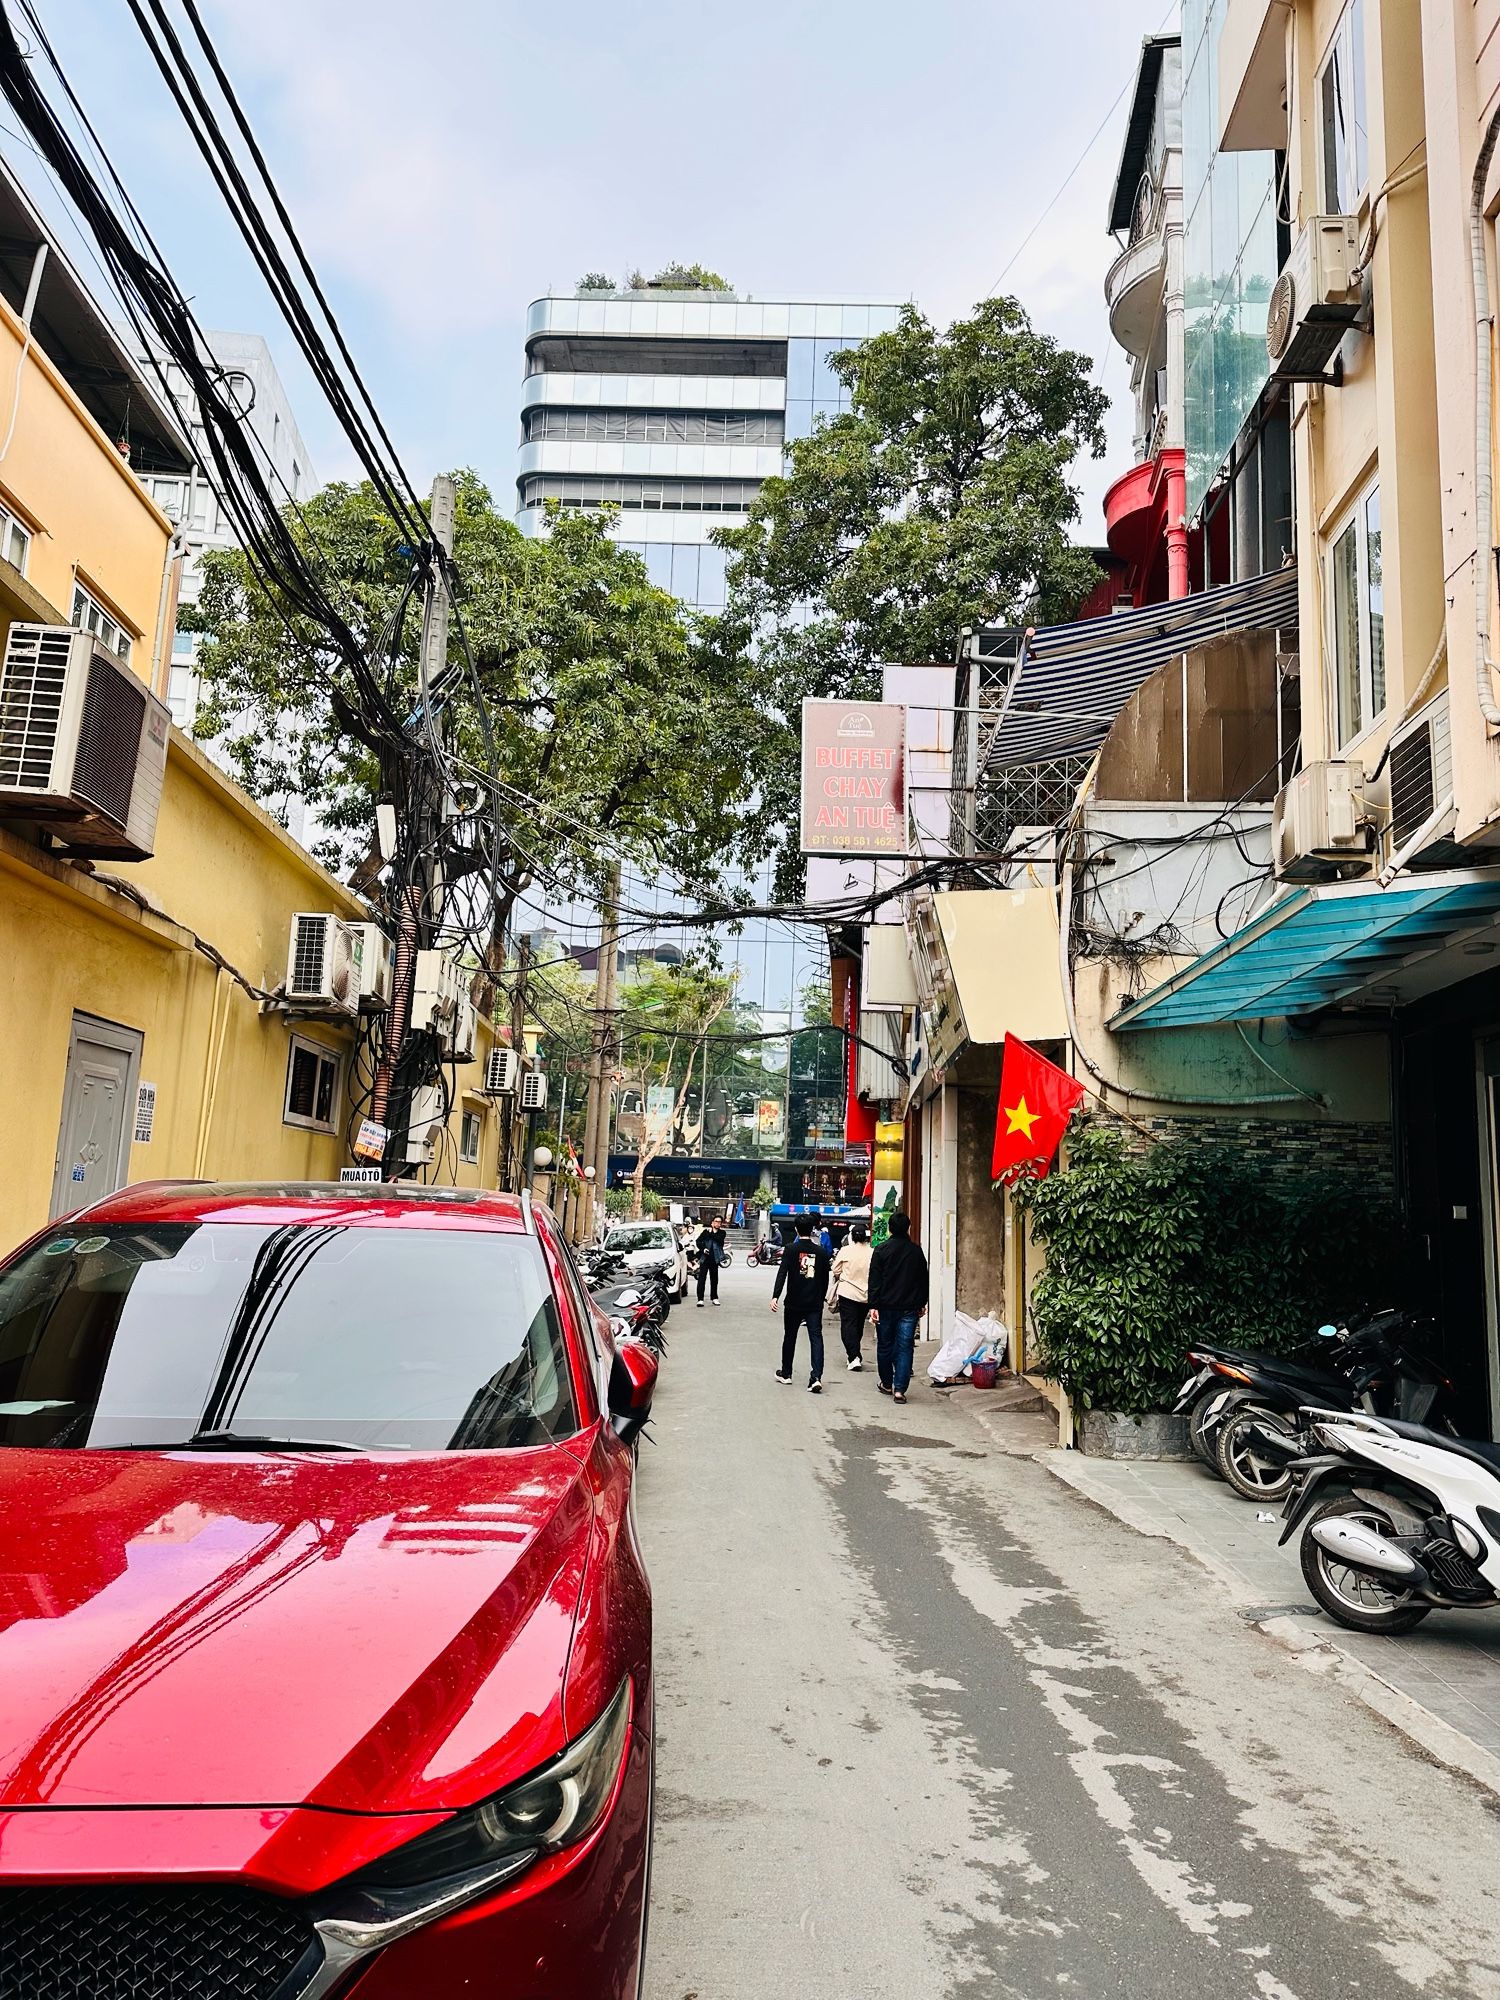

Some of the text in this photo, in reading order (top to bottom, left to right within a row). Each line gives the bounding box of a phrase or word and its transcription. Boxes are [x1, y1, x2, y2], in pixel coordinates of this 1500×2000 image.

[815, 746, 896, 770] BUFFET
[823, 775, 888, 799] CHAY
[814, 801, 896, 834] AN TUỆ
[811, 835, 898, 847] ĐT: 038 581 4625
